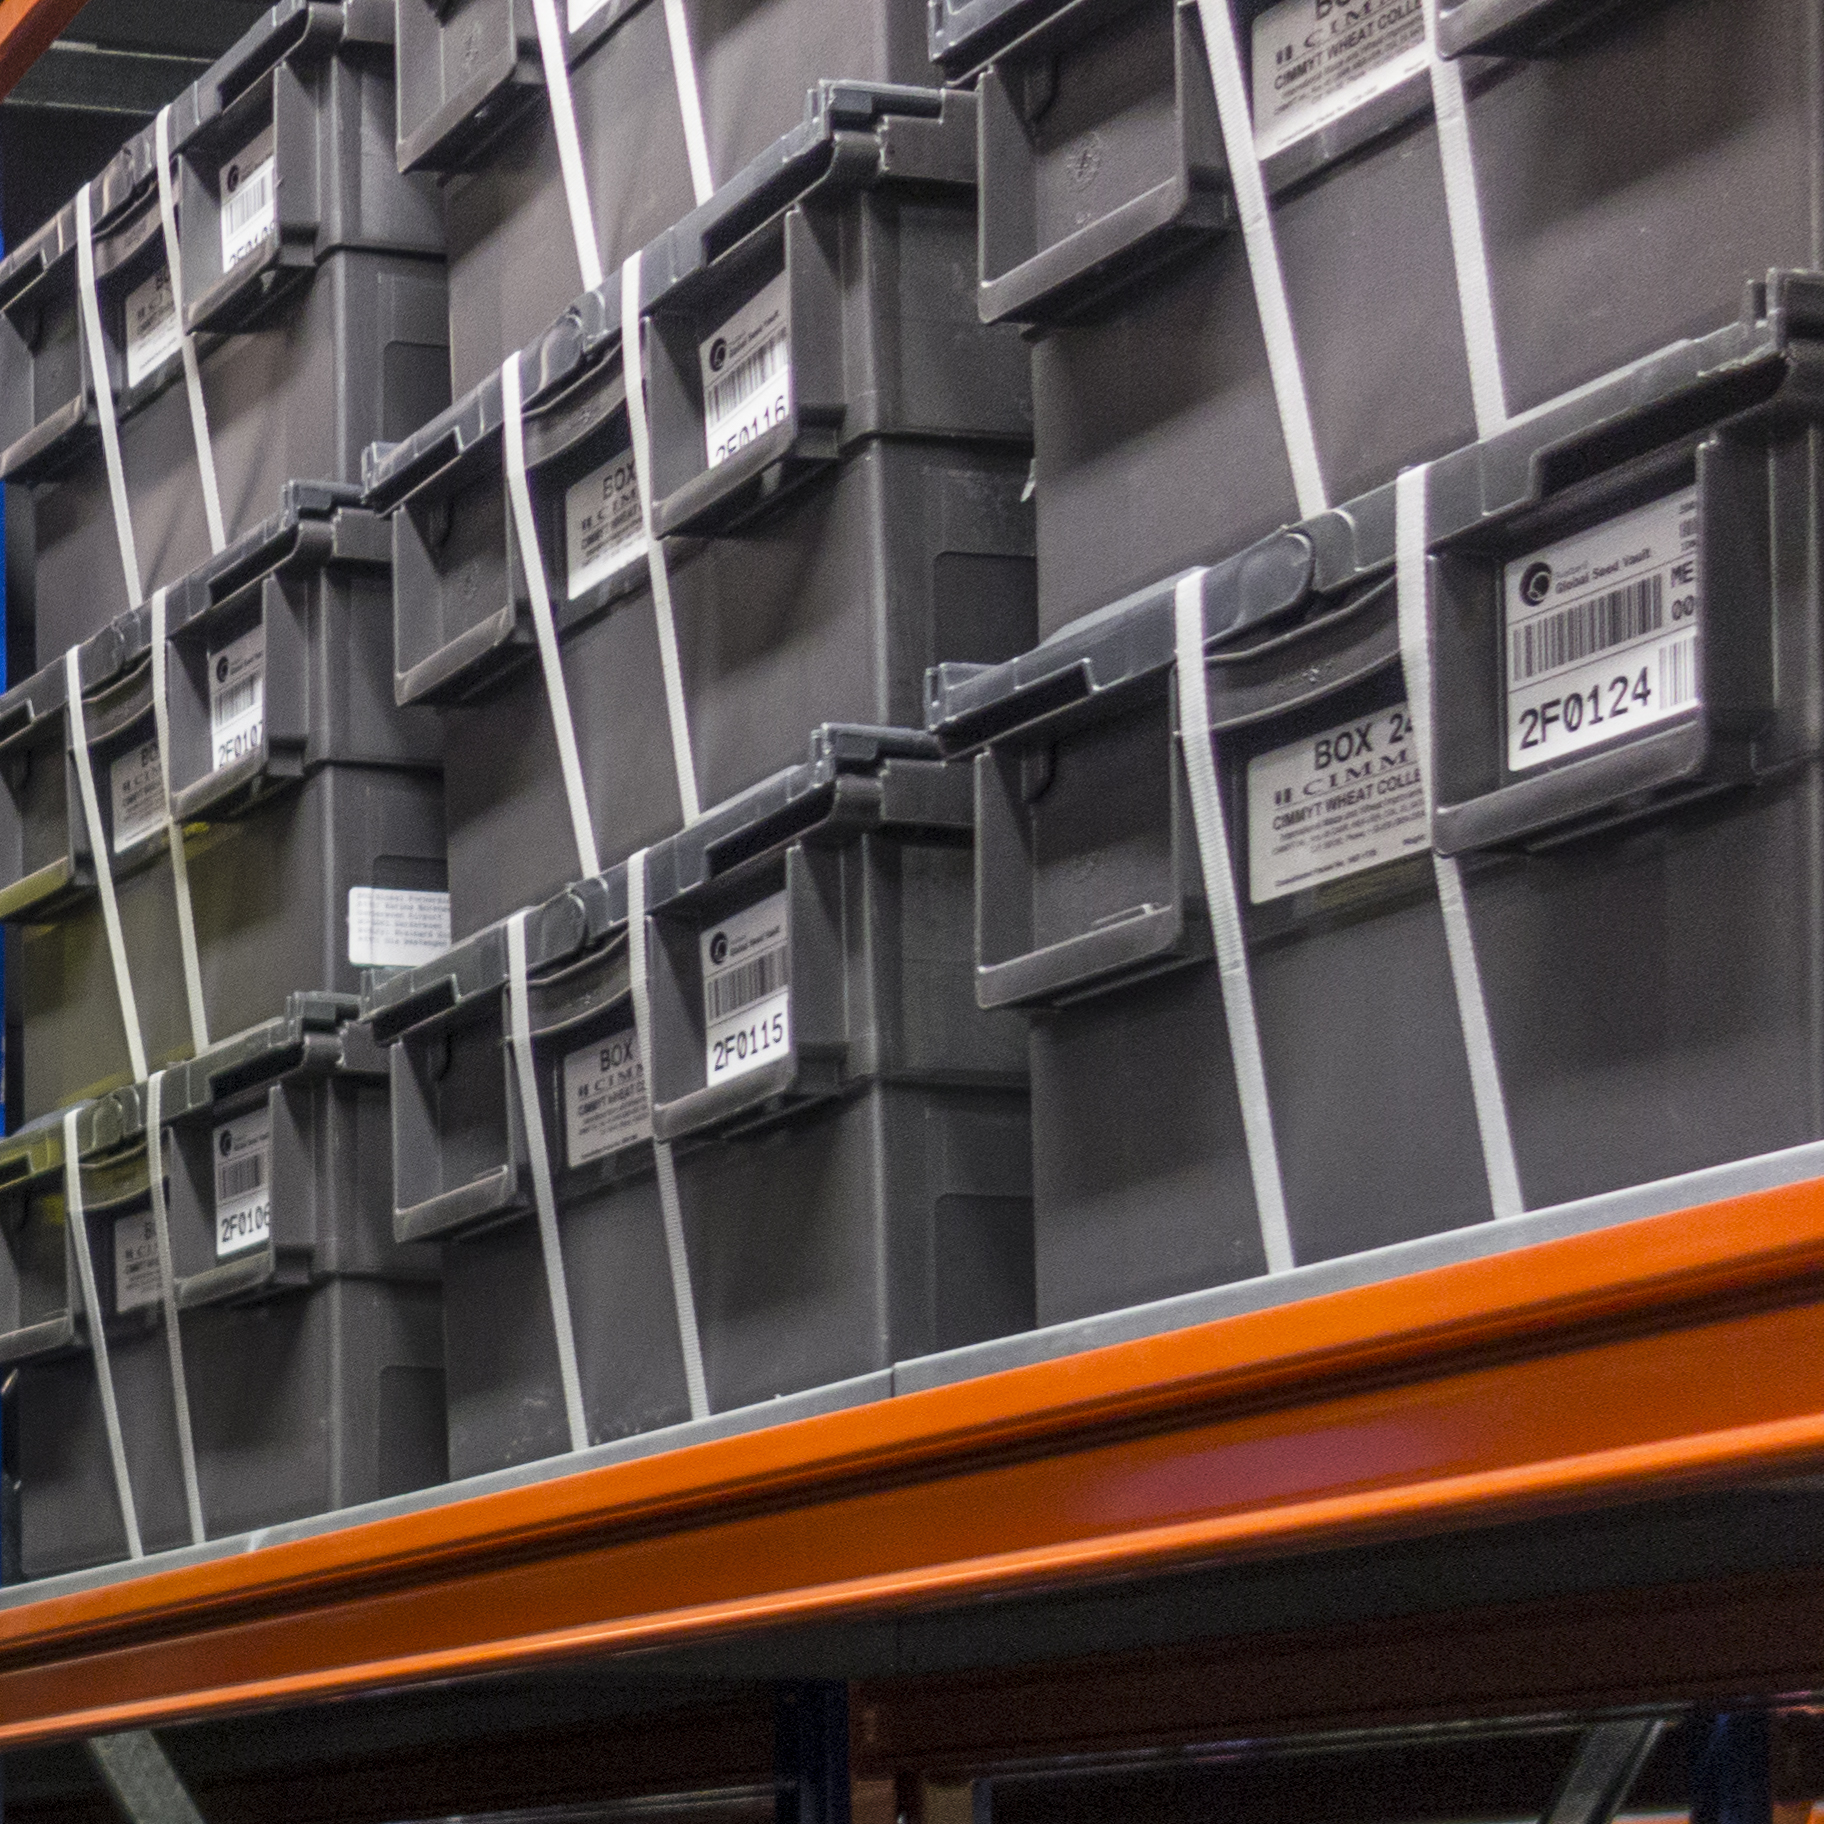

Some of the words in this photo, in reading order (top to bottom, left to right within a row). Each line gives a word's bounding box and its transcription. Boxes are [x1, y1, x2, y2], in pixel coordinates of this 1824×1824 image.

[1274, 52, 1323, 90] CIMMYT
[1327, 22, 1375, 60] WHEAT
[1377, 0, 1424, 30] COLLE
[1671, 560, 1694, 588] ME
[1671, 595, 1695, 621] 00
[1519, 665, 1652, 751] 2F0124
[1313, 721, 1374, 771] BOX
[1303, 748, 1409, 797] CIMM
[1272, 802, 1324, 831] CIMMYT
[1326, 783, 1374, 812] WHEAT
[1377, 767, 1422, 797] COLLE
[599, 1037, 634, 1073] BOX
[713, 1012, 784, 1072] 2F0115
